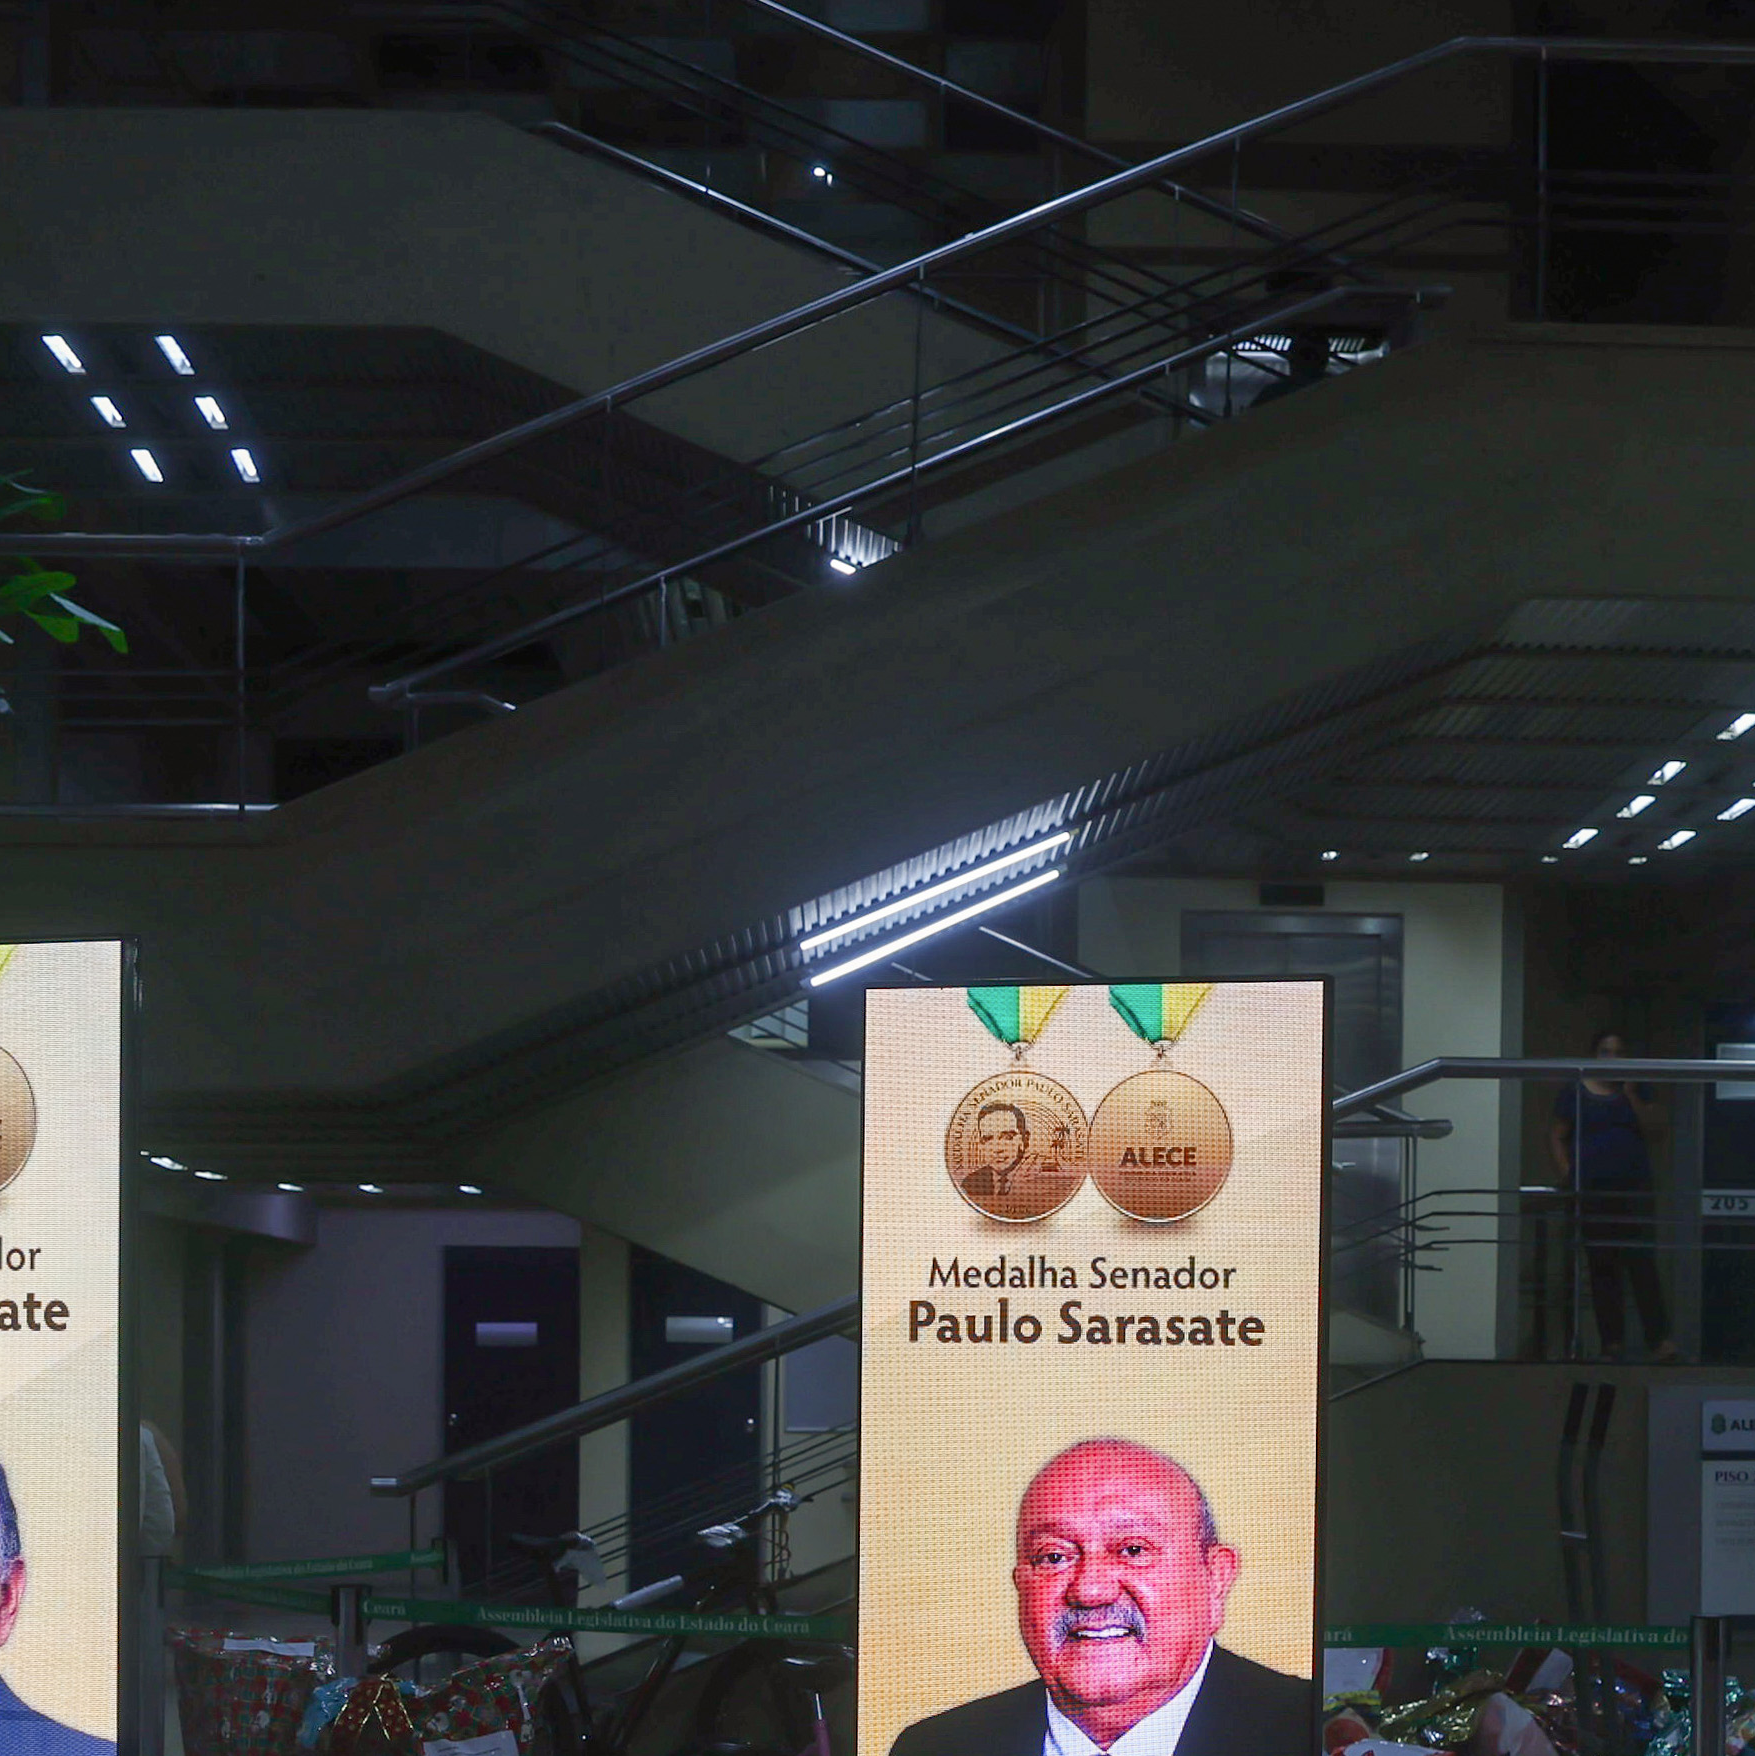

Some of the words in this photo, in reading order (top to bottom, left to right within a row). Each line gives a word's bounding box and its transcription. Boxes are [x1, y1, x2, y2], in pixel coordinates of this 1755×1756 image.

[1120, 1146, 1198, 1167] ALECE
[928, 1255, 1078, 1290] Medalha
[1089, 1256, 1237, 1290] Senador
[908, 1297, 1043, 1344] Paulo
[1056, 1300, 1266, 1347] Sarasate
[1715, 1470, 1749, 1483] PISO
[362, 1599, 407, 1616] Ceará
[476, 1605, 564, 1625] Assembleia
[567, 1611, 652, 1630] Legislativa
[655, 1612, 676, 1629] do
[679, 1613, 735, 1632] Estado
[738, 1615, 759, 1633] do
[762, 1617, 810, 1635] Ceará
[1323, 1626, 1353, 1642] ará
[1445, 1625, 1552, 1643] Assembleia
[1556, 1626, 1659, 1645] Legislativa
[1662, 1626, 1689, 1644] do
